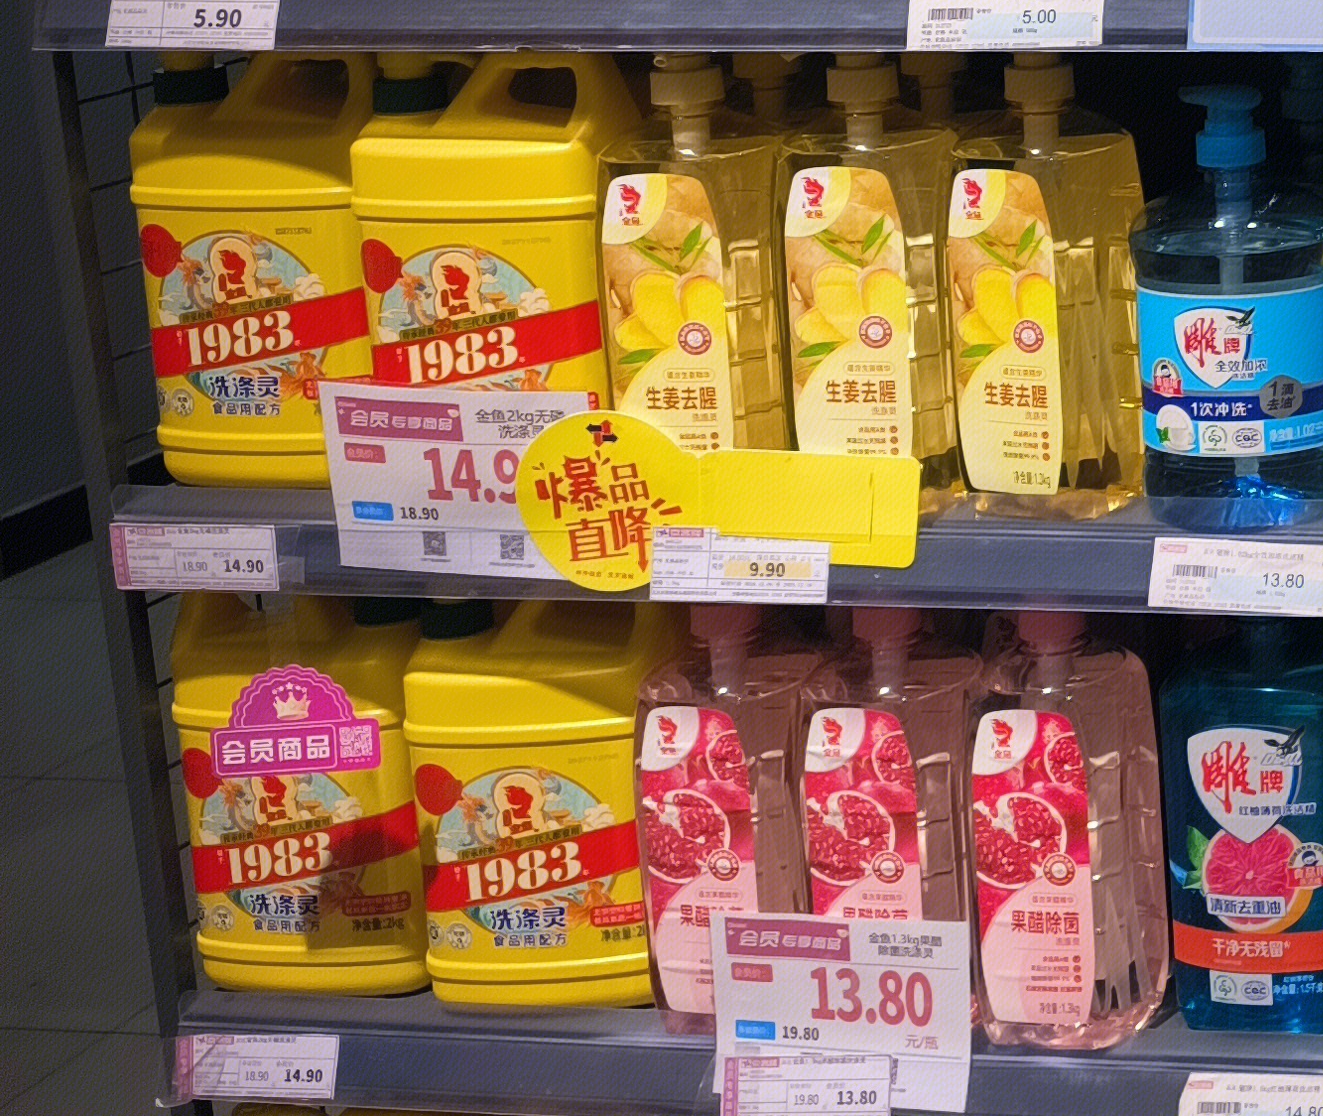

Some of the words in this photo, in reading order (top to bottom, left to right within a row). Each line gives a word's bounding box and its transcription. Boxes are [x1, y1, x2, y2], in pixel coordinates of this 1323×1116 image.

[194, 9, 242, 28] 5.90
[1022, 9, 1057, 24] 5.00
[186, 312, 295, 367] 1983
[409, 326, 518, 384] 1983
[1215, 358, 1268, 374] 全效加浓
[647, 386, 717, 411] 生姜去腥
[985, 382, 1049, 408] 生姜去腥
[1190, 403, 1248, 418] 1次冲洗
[535, 455, 650, 519] 爆品
[400, 507, 439, 520] 18.90
[567, 511, 653, 574] 直降
[182, 562, 207, 572] 18.90
[223, 559, 264, 573] 14.90
[748, 561, 786, 578] 9.90
[1263, 572, 1304, 588] 13.80
[221, 736, 331, 764] 会员商品
[227, 832, 331, 884] 1983
[465, 841, 583, 902] 1983
[1210, 899, 1281, 916] 清新去重油
[490, 907, 566, 930] 洗涤灵
[493, 934, 567, 948] 食品用配方
[810, 967, 933, 1027] 13.80
[782, 1026, 819, 1040] 19.80
[284, 1069, 323, 1082] 14.90
[794, 1094, 819, 1106] 19.80
[837, 1091, 877, 1105] 13.80
